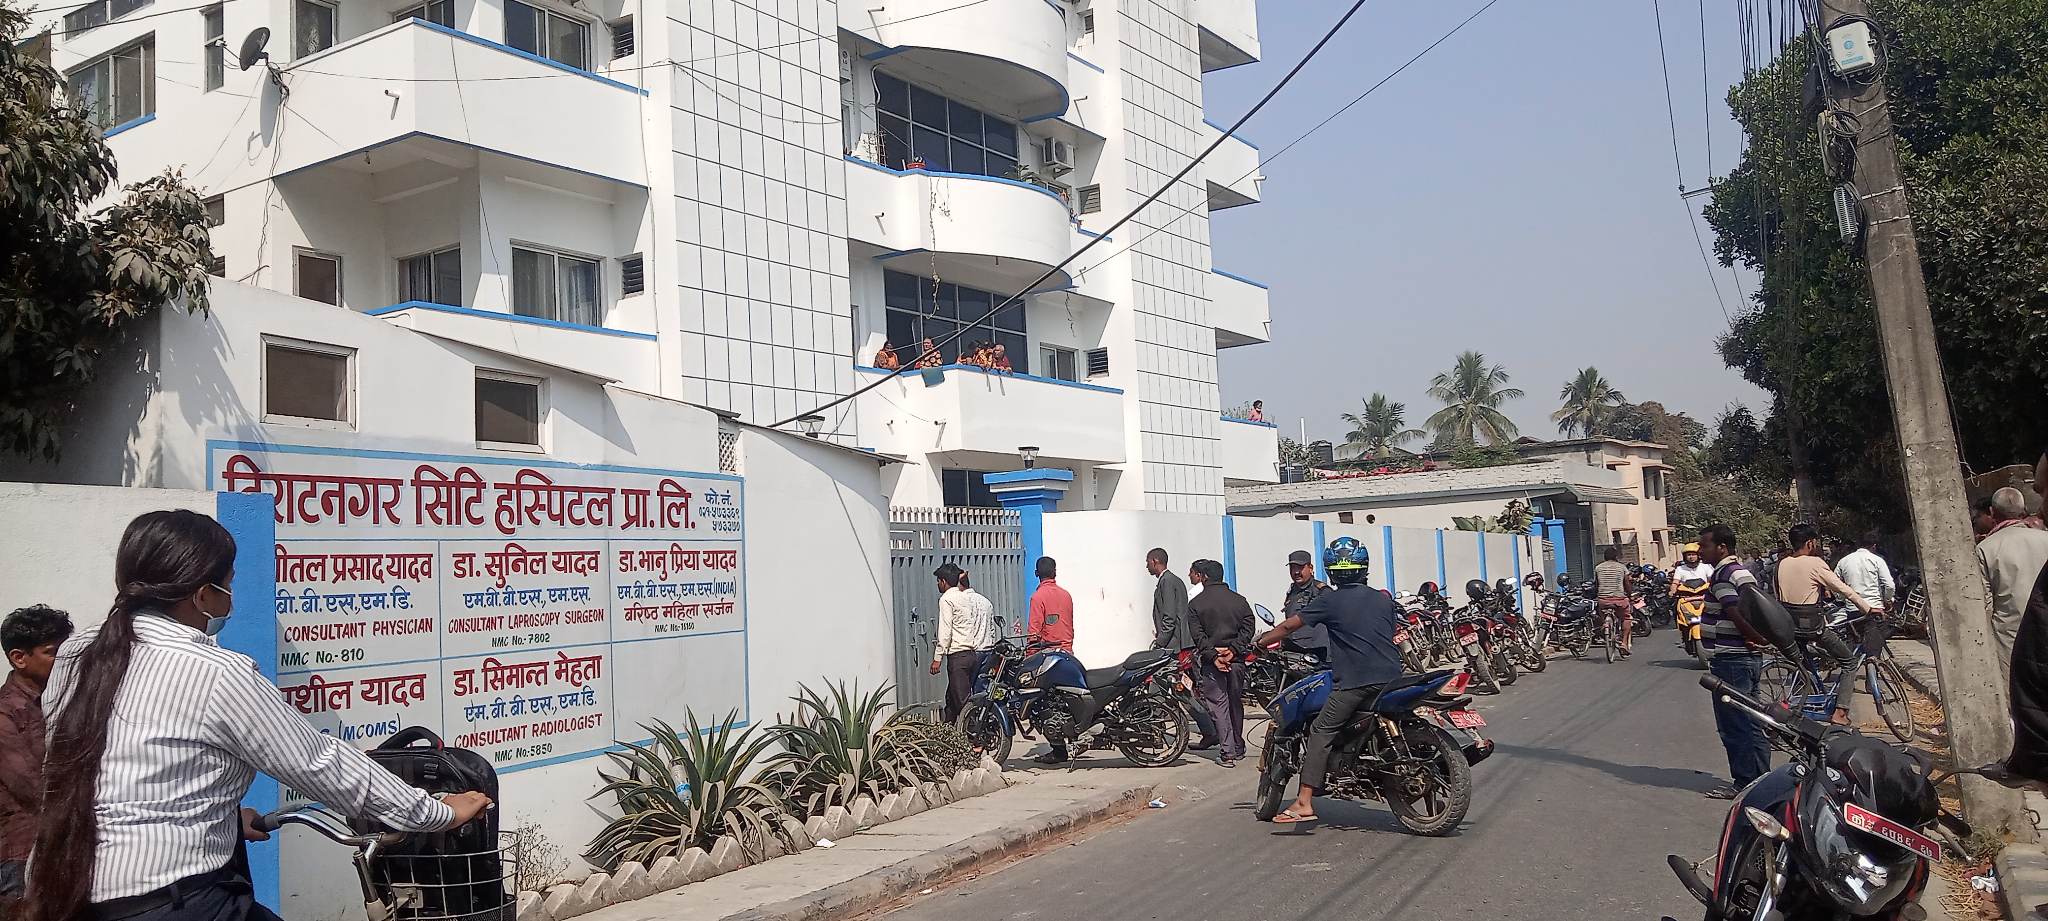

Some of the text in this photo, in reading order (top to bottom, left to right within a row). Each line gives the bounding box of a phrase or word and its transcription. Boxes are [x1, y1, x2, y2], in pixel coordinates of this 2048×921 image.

[411, 464, 487, 526] सिटि
[494, 468, 616, 535] हस्पिटल
[275, 543, 328, 584] ीतल
[386, 553, 433, 583] यादव
[484, 542, 547, 589] सुनिल
[552, 550, 600, 577] यादव
[670, 543, 700, 574] प्रिया
[703, 550, 737, 572] यादव
[448, 608, 605, 634] CONSULTANT LAPROSCOPY SURGEON
[662, 601, 700, 620] महिला
[702, 598, 735, 618] सर्जन
[284, 617, 433, 643] CONSULTANT PHYSICIAN
[491, 636, 509, 648] NMC
[280, 652, 310, 667] NMC
[482, 657, 550, 692] सिमान्त
[554, 651, 602, 687] मेहता
[360, 673, 427, 708] यादव
[454, 713, 603, 750] CONSULTANT RADIOLOGIST
[494, 749, 513, 762] NMC
